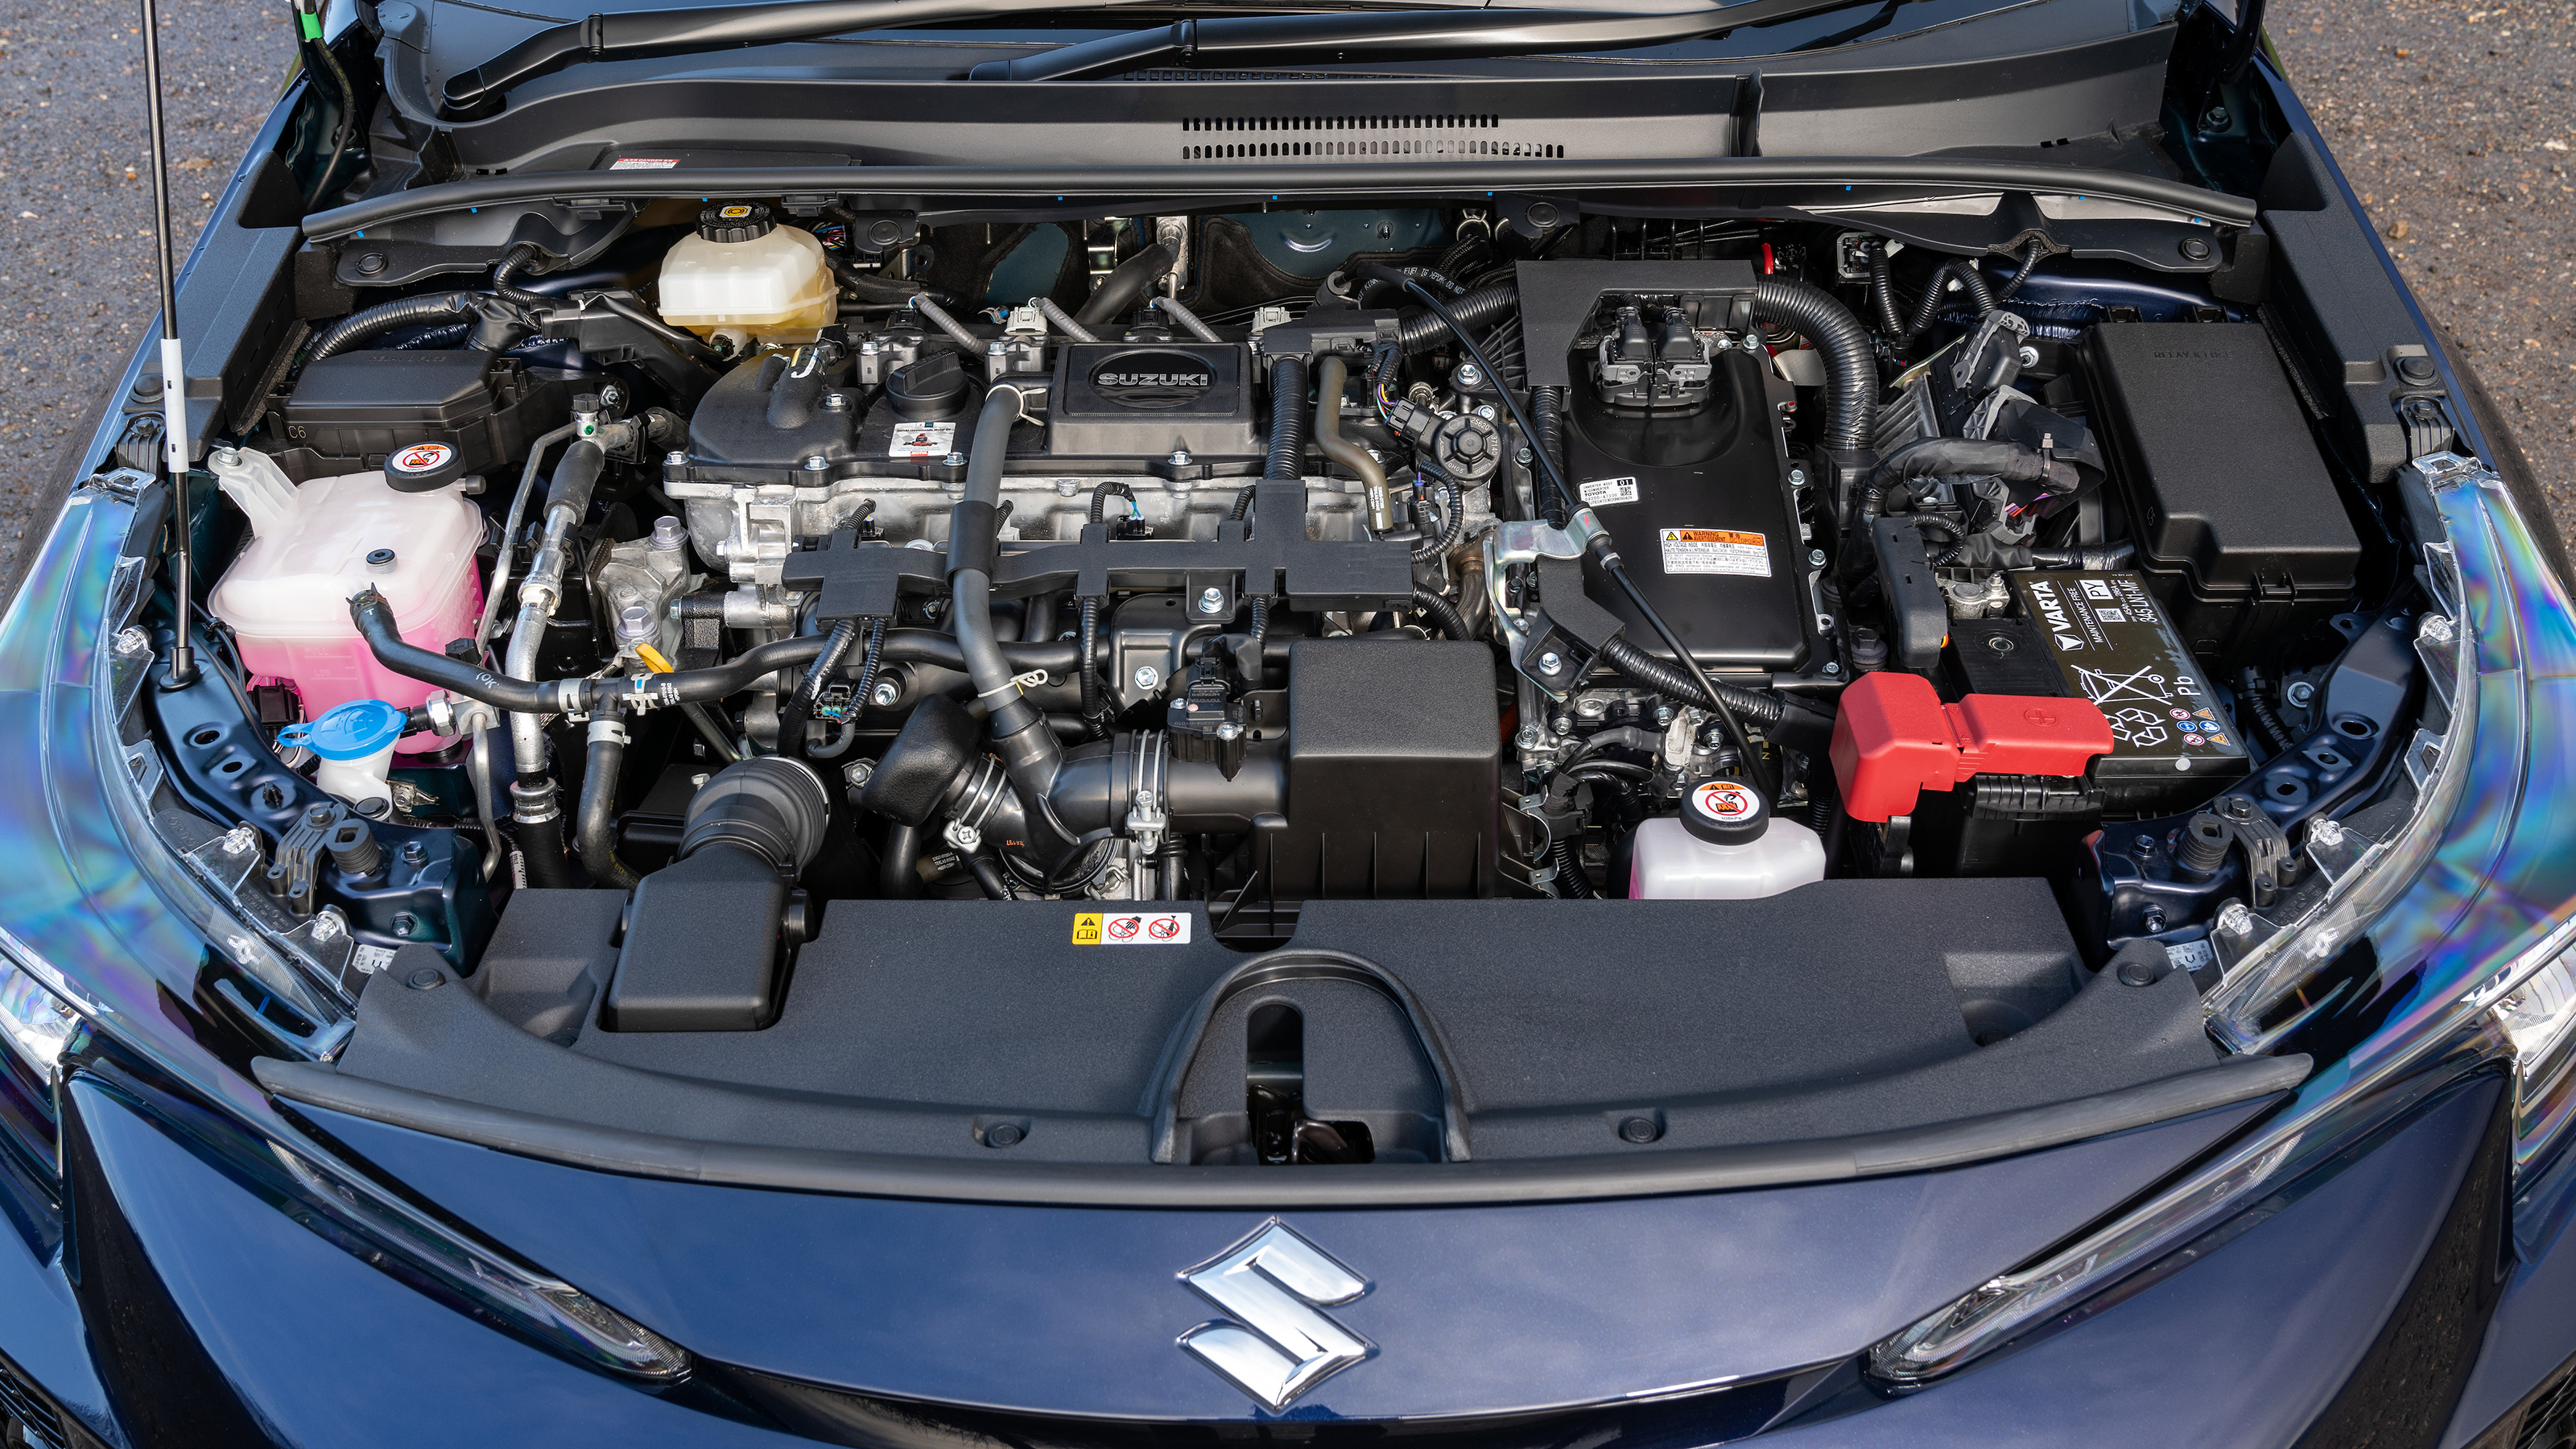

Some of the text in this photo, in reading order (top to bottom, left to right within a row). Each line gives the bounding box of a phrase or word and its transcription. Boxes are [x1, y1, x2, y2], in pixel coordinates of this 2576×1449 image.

[1453, 286, 1466, 295] NOT
[1097, 373, 1208, 386] SUZUKI
[1471, 417, 1490, 431] 25620
[288, 426, 307, 439] C6
[1474, 462, 1492, 475] TOYOTA
[2147, 506, 2156, 526] C5
[2084, 581, 2109, 597] PY
[2030, 580, 2072, 632] VARTA
[2116, 580, 2158, 623] 345 LN1-MF
[2066, 587, 2104, 643] MAINTENANCE FREE
[2121, 603, 2133, 616] 45Ah
[2173, 675, 2201, 696] Pb
